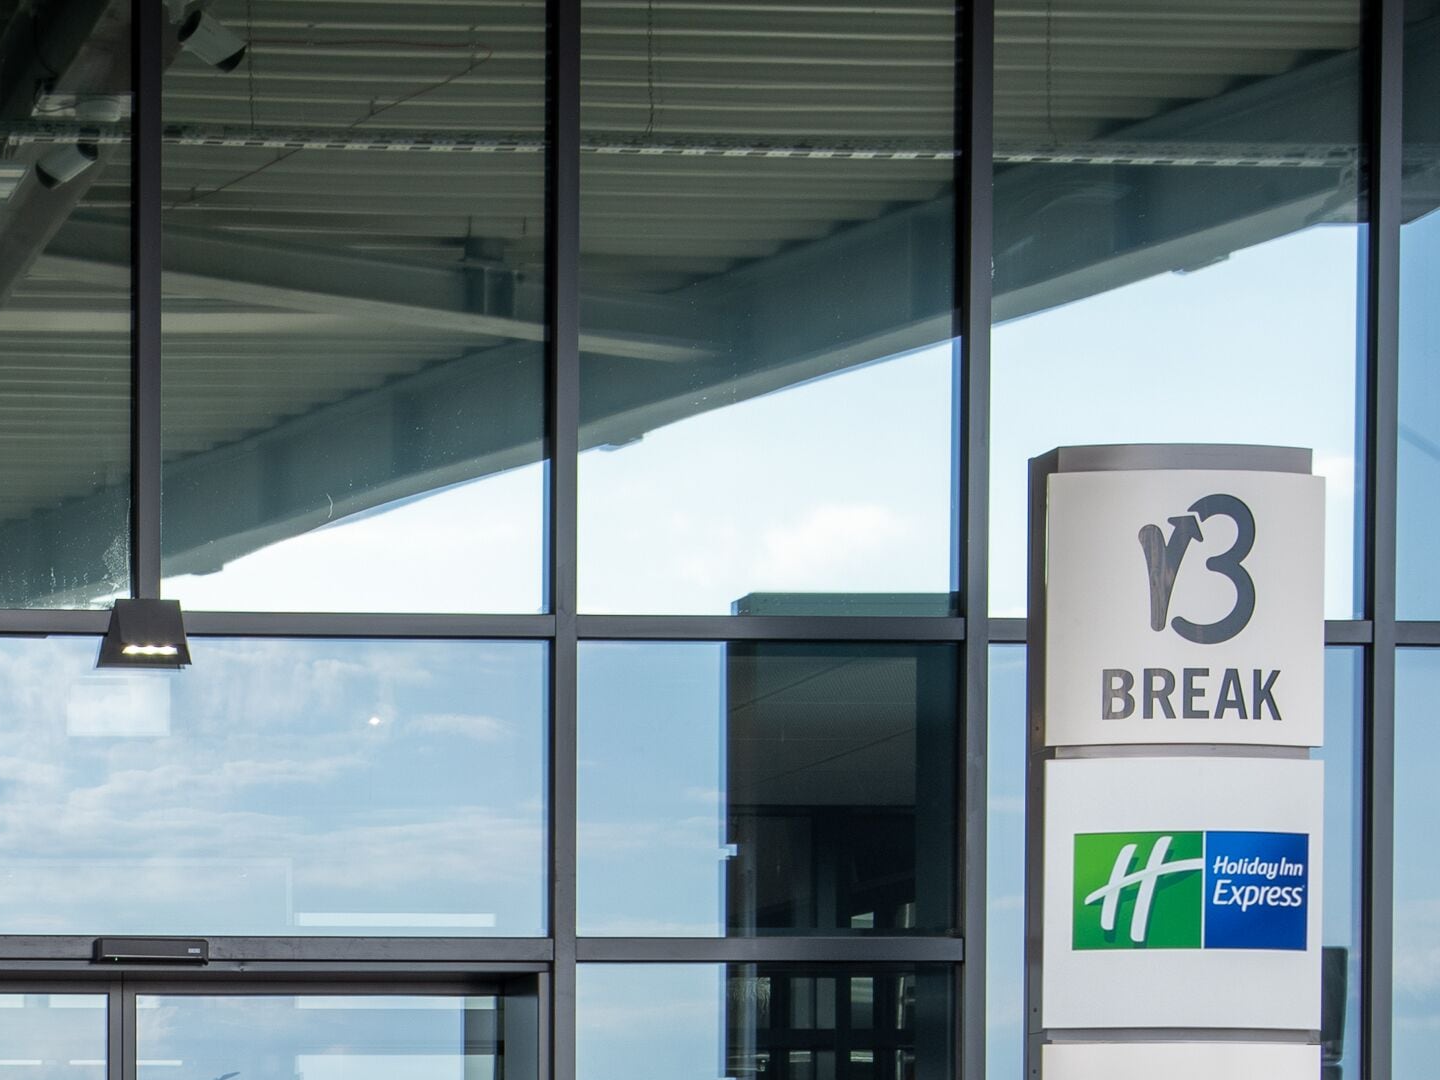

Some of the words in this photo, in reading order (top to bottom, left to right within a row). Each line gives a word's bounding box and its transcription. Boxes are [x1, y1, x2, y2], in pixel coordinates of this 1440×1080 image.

[1101, 667, 1282, 721] BREAK
[1213, 856, 1279, 880] Holiday
[1279, 857, 1303, 876] Inn
[1213, 879, 1304, 912] Express
